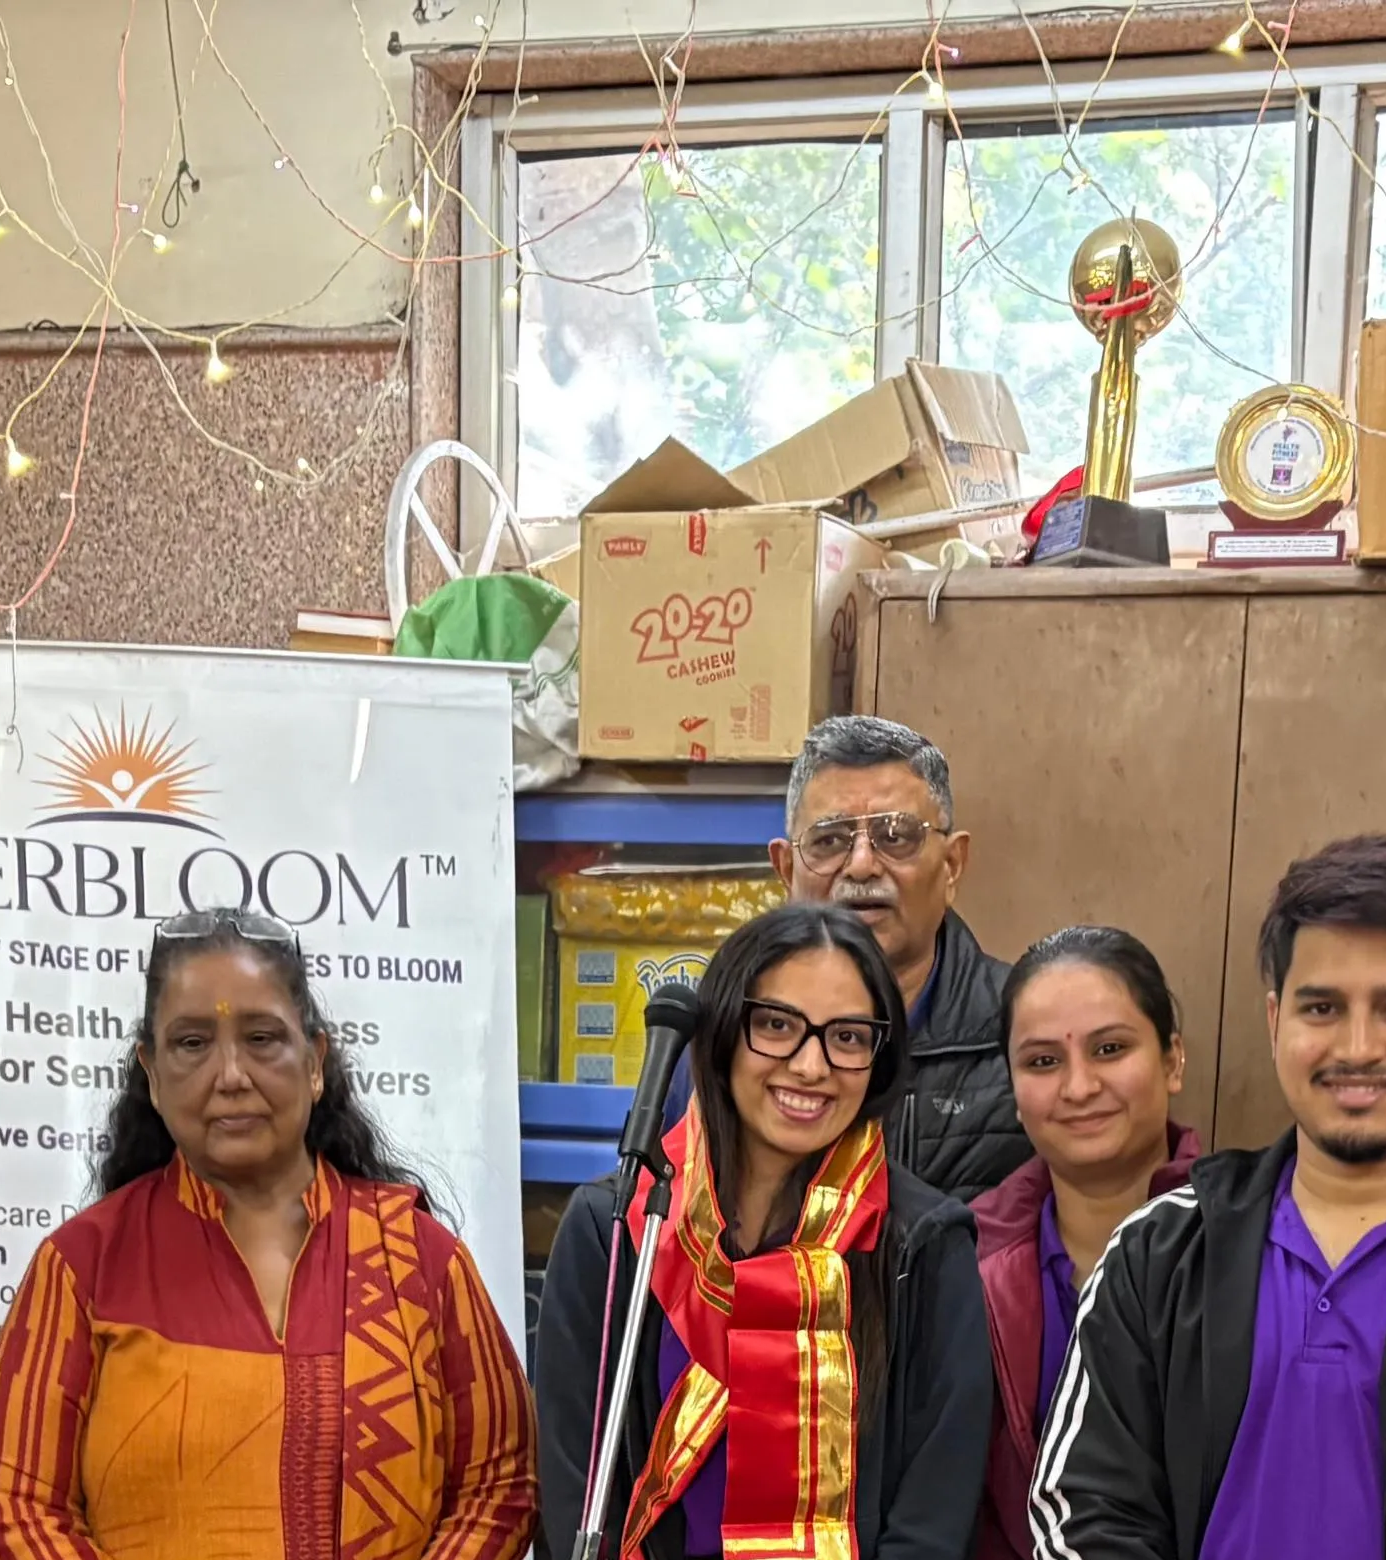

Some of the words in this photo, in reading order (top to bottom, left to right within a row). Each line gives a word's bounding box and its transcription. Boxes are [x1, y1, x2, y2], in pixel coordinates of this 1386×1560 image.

[630, 587, 752, 664] 20-20
[666, 648, 735, 680] CASHEW
[9, 942, 89, 972] STAGE
[96, 948, 129, 973] OF
[338, 954, 370, 979] TO
[378, 957, 463, 984] BLOOM
[5, 1000, 123, 1040] Health
[46, 1055, 125, 1090] Seni
[37, 1124, 111, 1152] Geria
